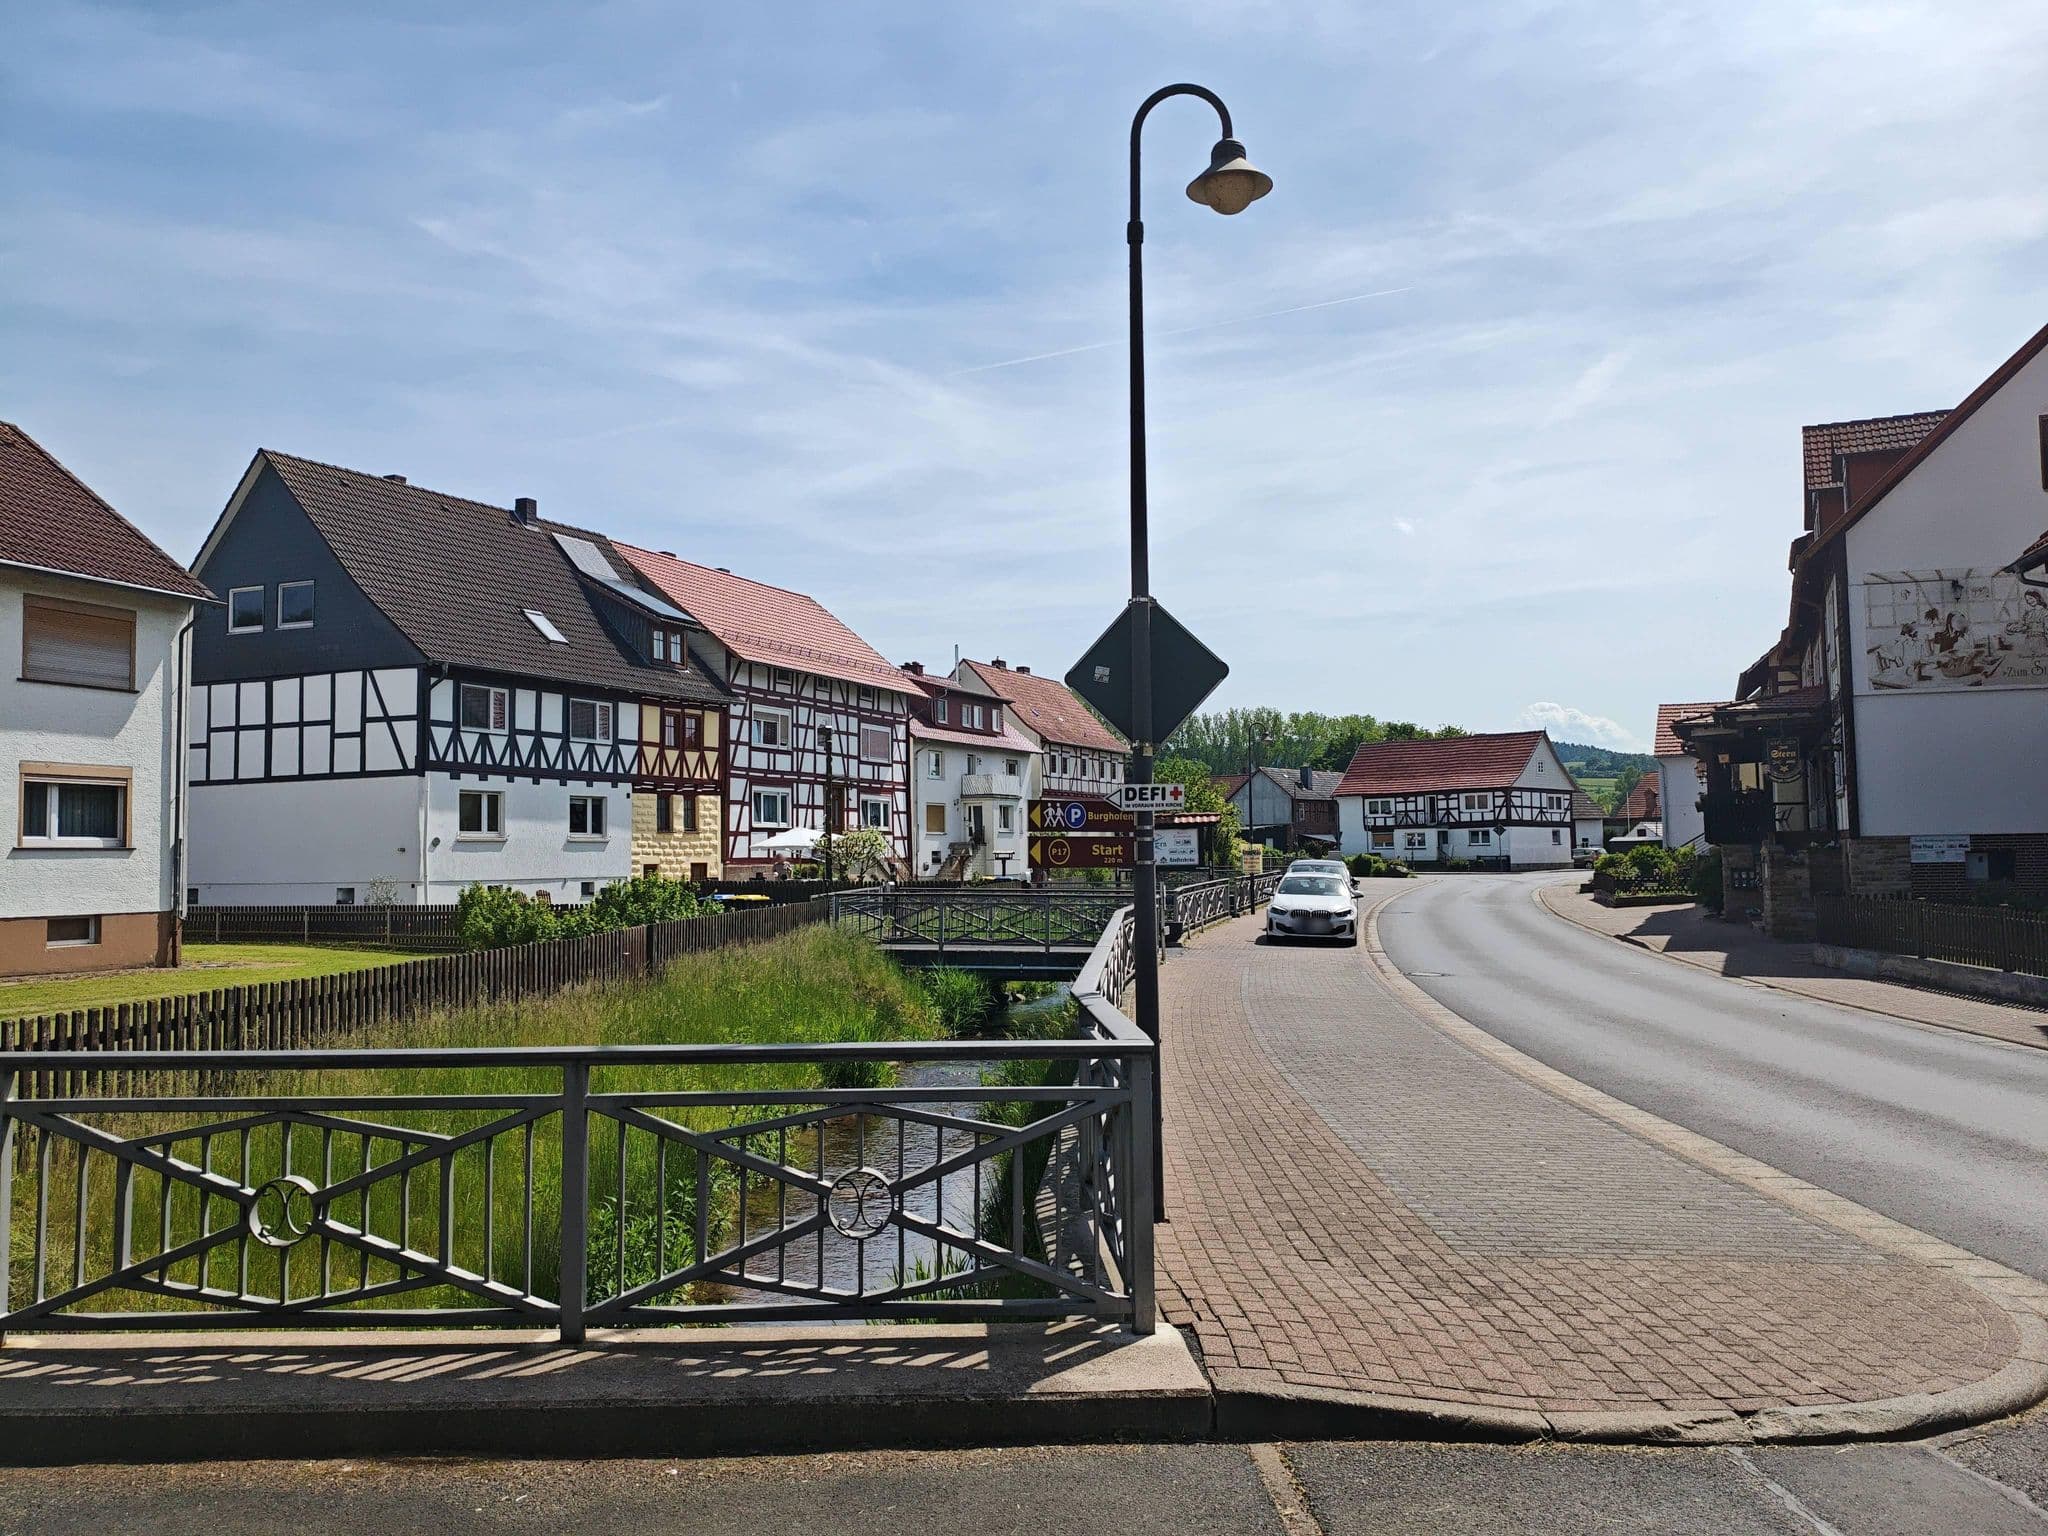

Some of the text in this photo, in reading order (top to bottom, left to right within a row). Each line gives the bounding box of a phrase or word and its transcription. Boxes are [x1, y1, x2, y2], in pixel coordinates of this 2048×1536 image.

[1770, 749, 1796, 758] Stern
[1124, 786, 1166, 801] DEFI
[1071, 808, 1134, 823] P Burghofen
[1051, 844, 1123, 856] P17 Start
